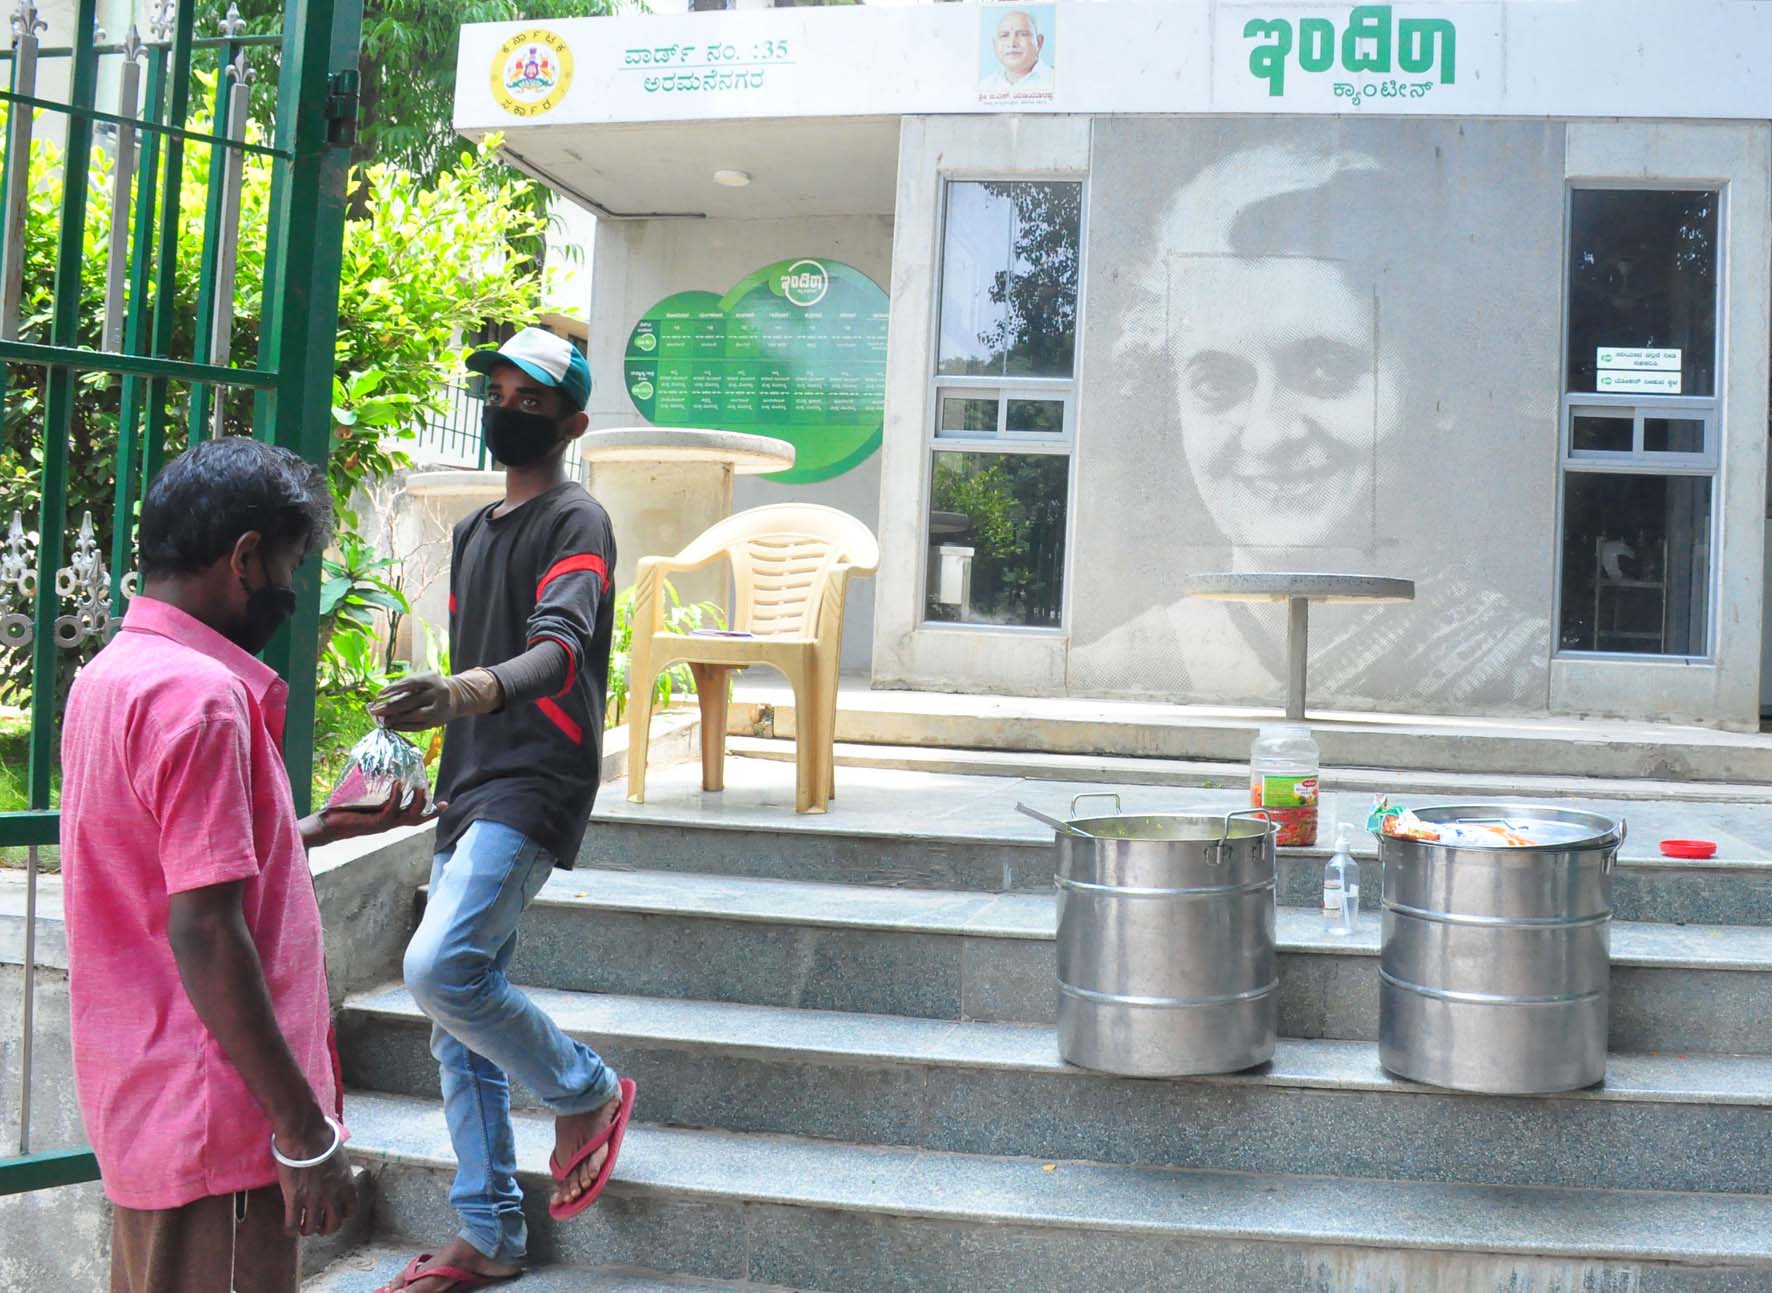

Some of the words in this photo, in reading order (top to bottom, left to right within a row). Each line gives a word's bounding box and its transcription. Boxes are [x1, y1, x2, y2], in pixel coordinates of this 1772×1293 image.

[624, 43, 695, 64] ವಾರ್ಡ್
[1243, 5, 1456, 97] ಇಂದಿರಾ
[643, 69, 764, 92] ಅರಮನೆನಗರ
[1332, 80, 1434, 106] ಕ್ಯಾಂಟೀನ್
